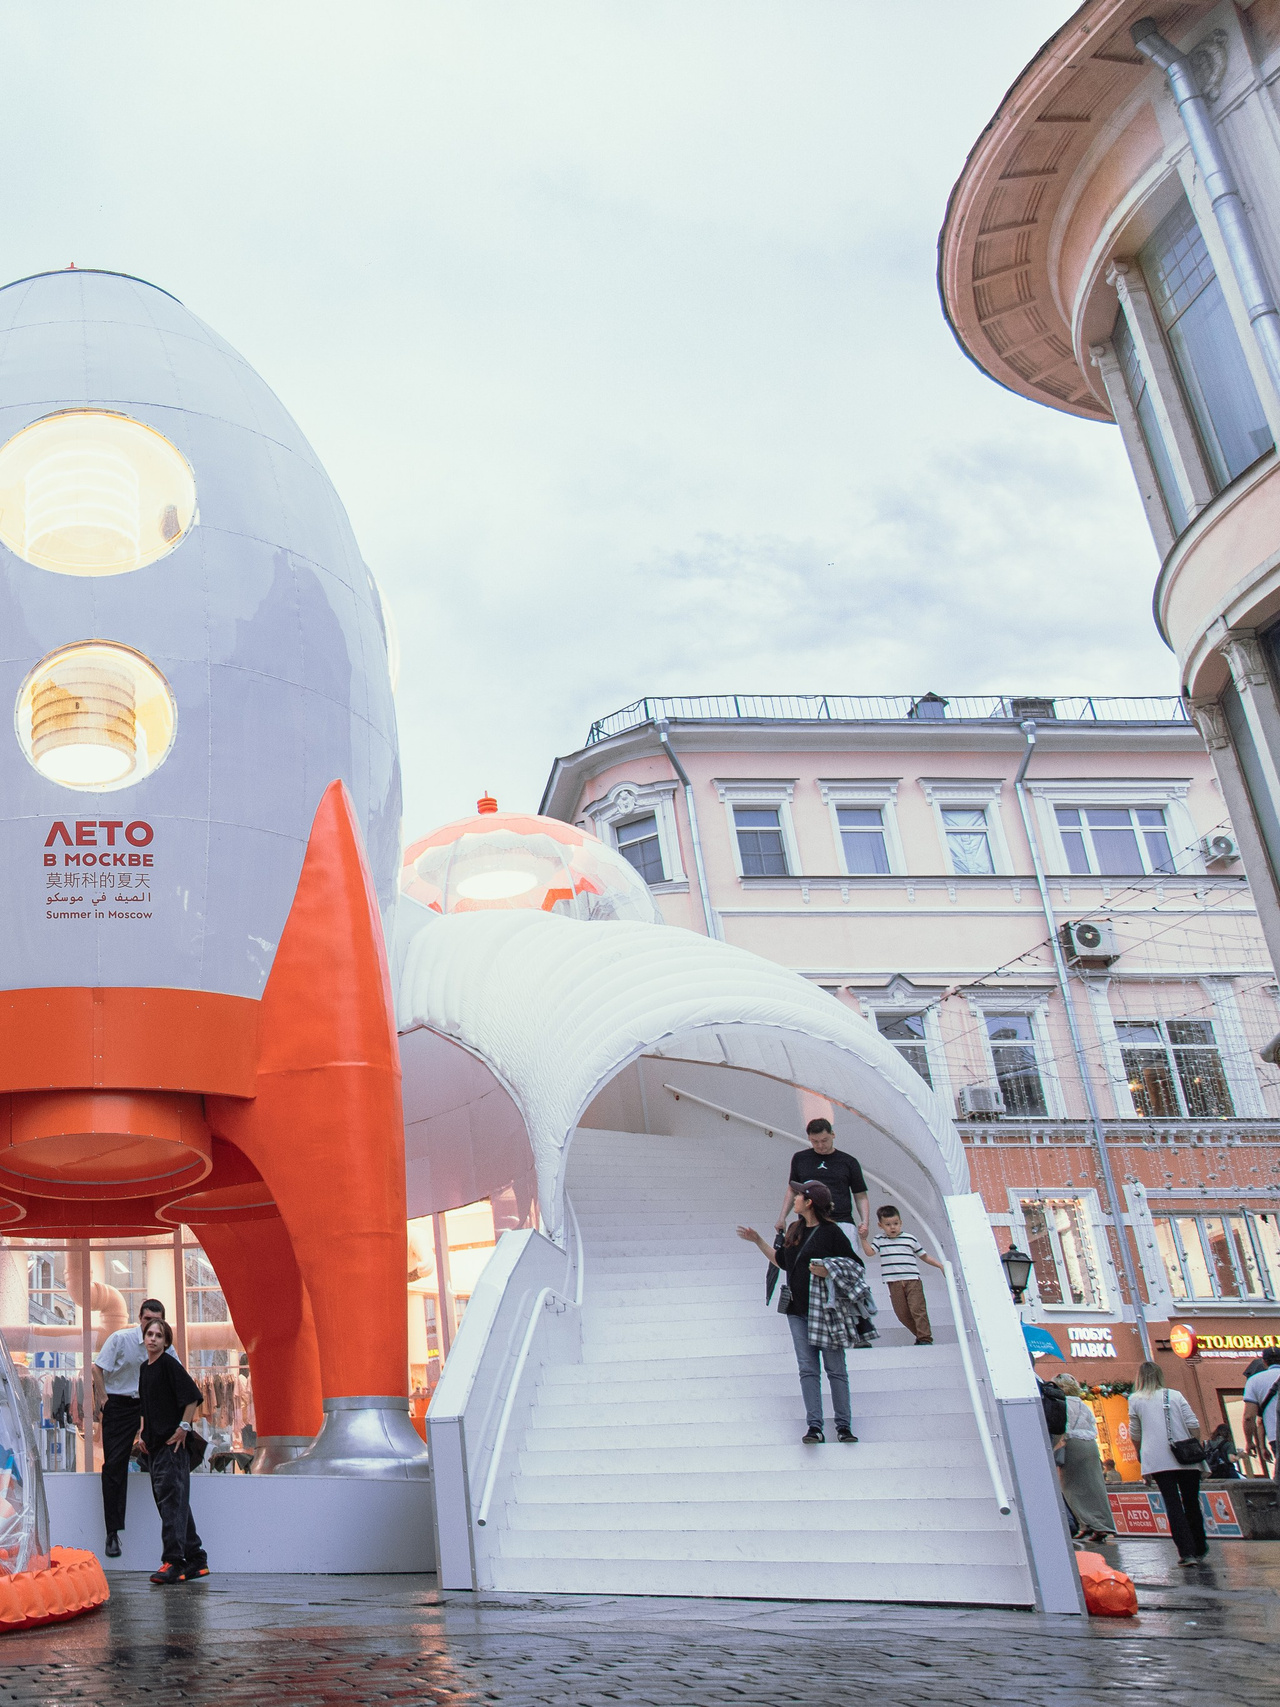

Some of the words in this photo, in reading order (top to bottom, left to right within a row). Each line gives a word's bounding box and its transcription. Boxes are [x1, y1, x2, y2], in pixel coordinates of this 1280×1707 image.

[43, 820, 154, 847] ЛЕТО
[43, 853, 57, 867] В
[64, 852, 154, 867] МОСКВЕ
[46, 872, 151, 889] 莫斯科的夏天
[46, 892, 84, 905] موسكو
[91, 892, 107, 906] في
[114, 892, 151, 904] الصيف
[46, 910, 91, 919] Summer
[95, 909, 105, 919] in
[108, 910, 153, 919] Moscow
[1067, 1327, 1113, 1341] ГЛОБУС
[1070, 1342, 1117, 1358] ЛАВКА
[1127, 1509, 1150, 1520] ЛЕТО
